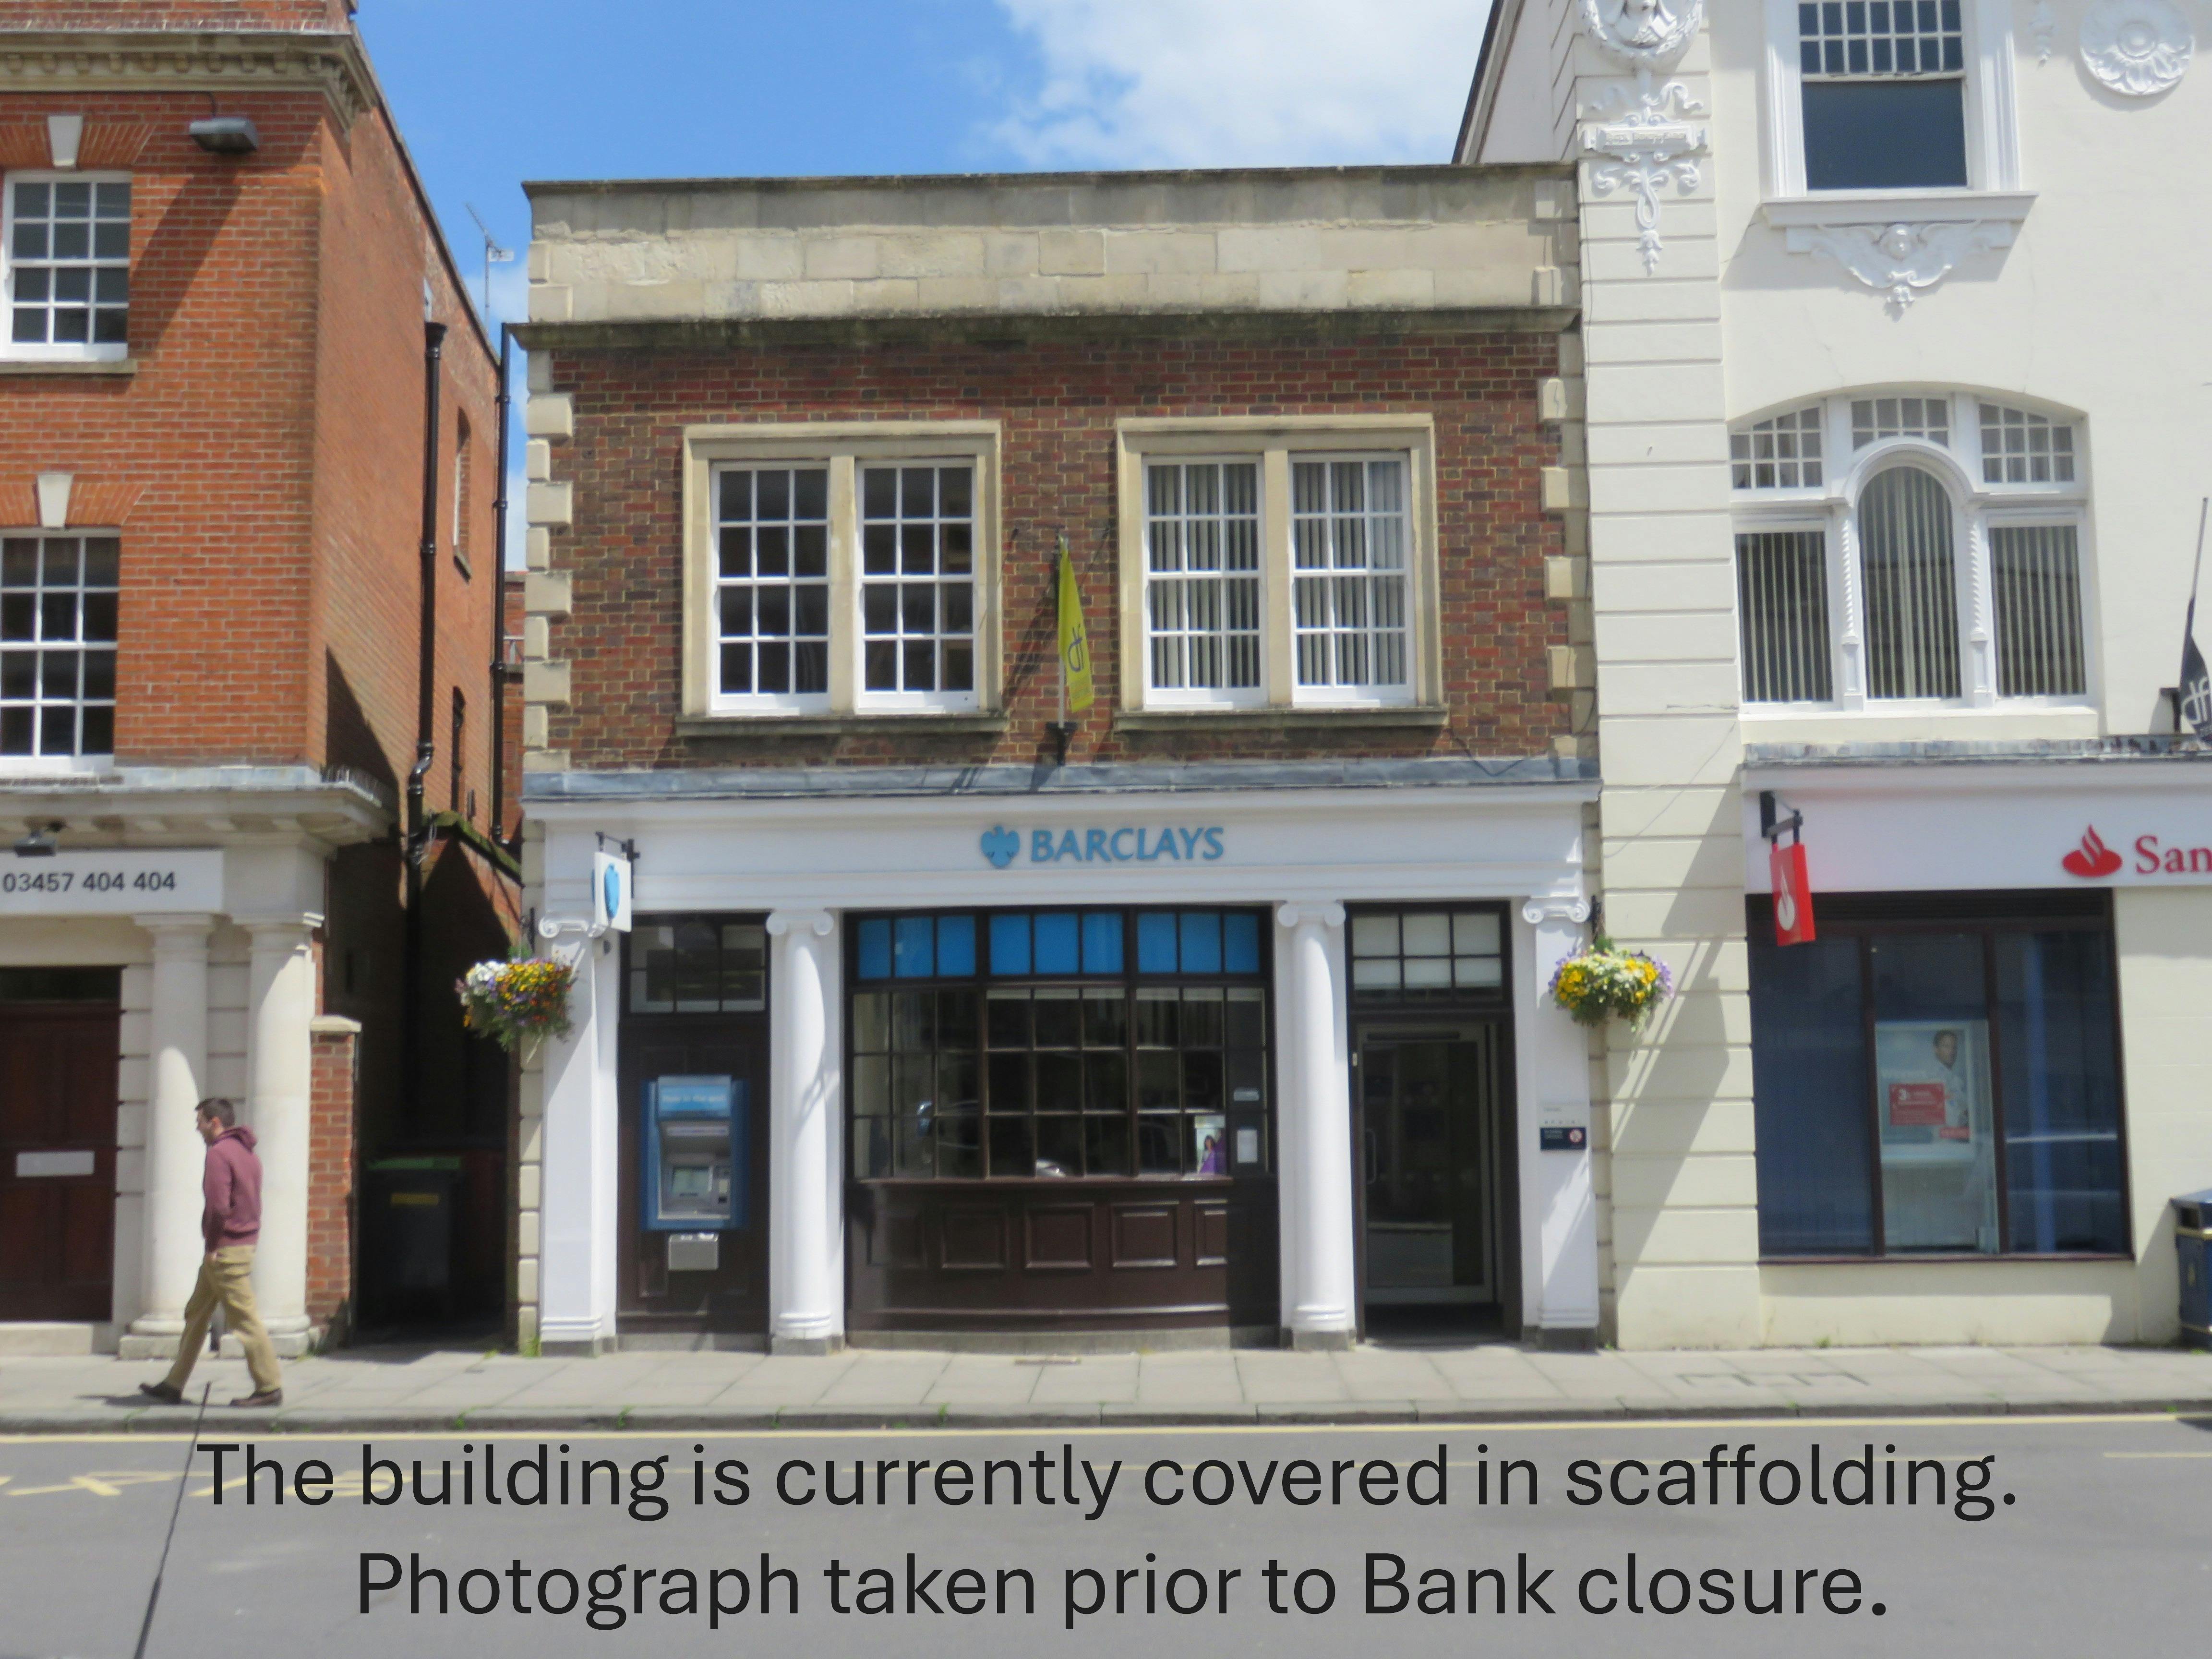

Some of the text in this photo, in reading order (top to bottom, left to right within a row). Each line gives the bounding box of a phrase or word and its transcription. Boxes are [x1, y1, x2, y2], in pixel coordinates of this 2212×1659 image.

[1030, 827, 1225, 862] BARCLAYS
[2135, 834, 2212, 874] San
[2, 871, 176, 892] 03457 404 404
